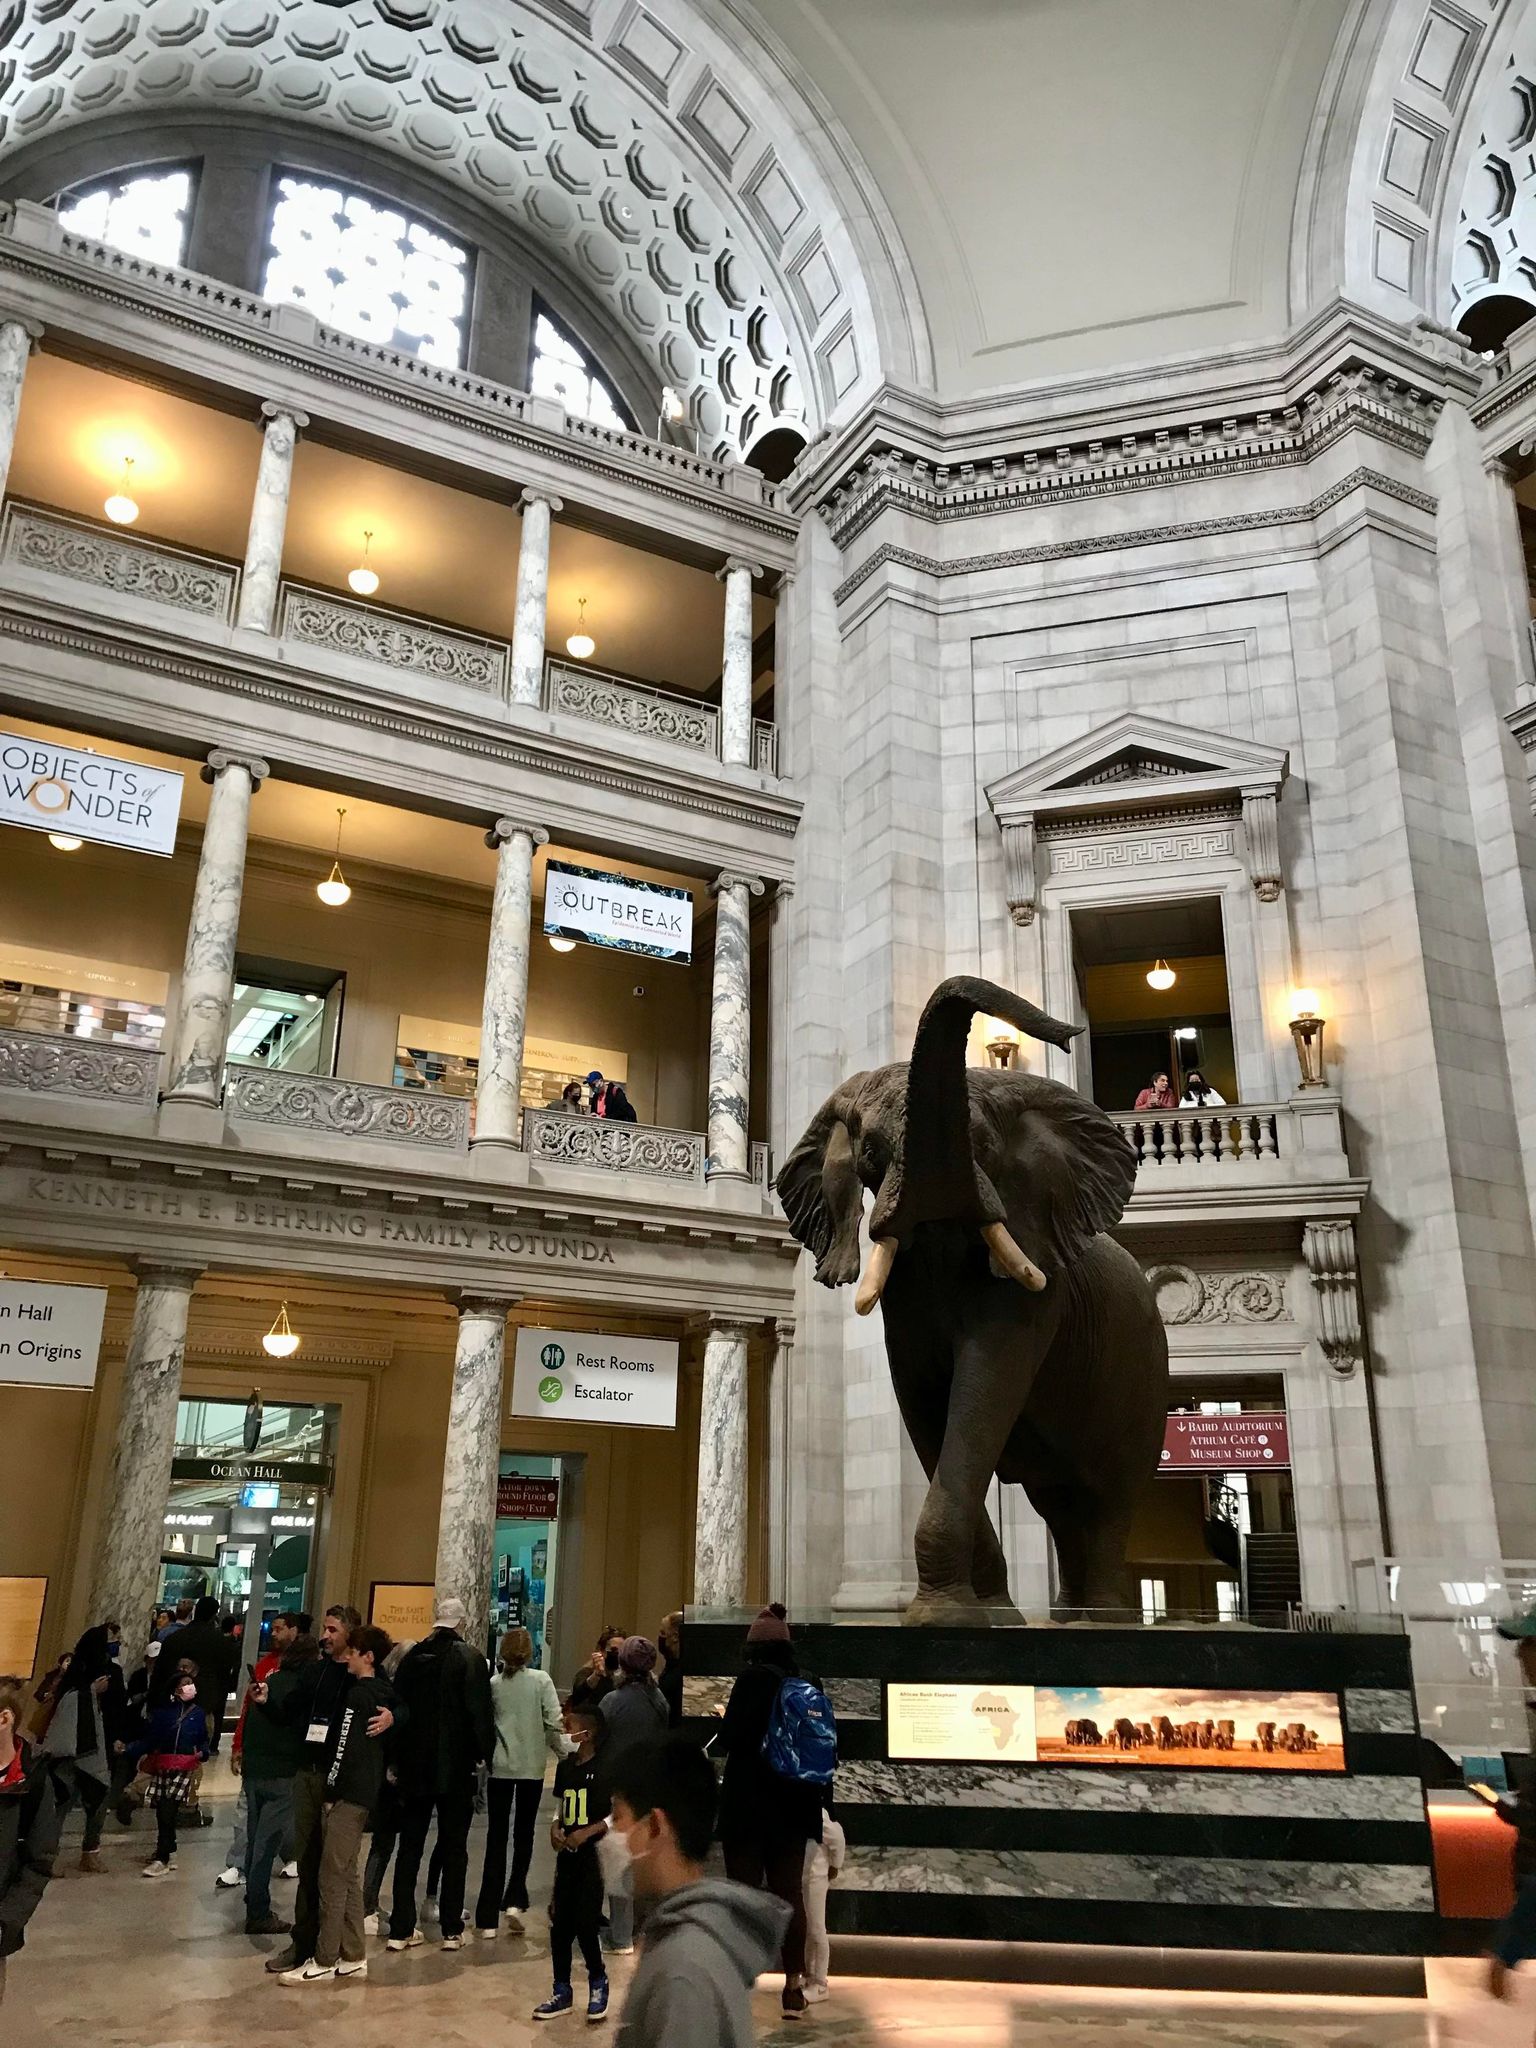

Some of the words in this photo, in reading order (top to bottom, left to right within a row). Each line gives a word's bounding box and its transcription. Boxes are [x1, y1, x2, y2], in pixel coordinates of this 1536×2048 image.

[3, 747, 138, 796] OBJECTS
[141, 783, 166, 803] of
[3, 774, 152, 828] WONDER
[562, 891, 682, 933] OUTBREAK
[28, 1177, 182, 1217] KENNETH
[198, 1196, 220, 1221] E.
[234, 1200, 367, 1238] BEHRING
[380, 1218, 478, 1249] FAMILY
[488, 1229, 616, 1265] ROTUNDA
[18, 1304, 53, 1321] Hall
[18, 1340, 82, 1362] Origins
[576, 1353, 605, 1369] Rest
[610, 1356, 655, 1373] Rooms
[574, 1384, 634, 1402] Escalator
[1188, 1422, 1219, 1432] BAIRD
[1222, 1421, 1284, 1431] AUDITORIUM
[1189, 1435, 1227, 1445] ATRIUM
[1230, 1434, 1257, 1445] CAFÉ
[1190, 1449, 1232, 1459] MUSEUM
[1235, 1448, 1262, 1459] SHOP
[210, 1464, 251, 1478] OCEAN
[253, 1465, 283, 1479] HALL
[522, 1492, 547, 1501] FLOOR
[335, 1707, 355, 1760] AMERICAN
